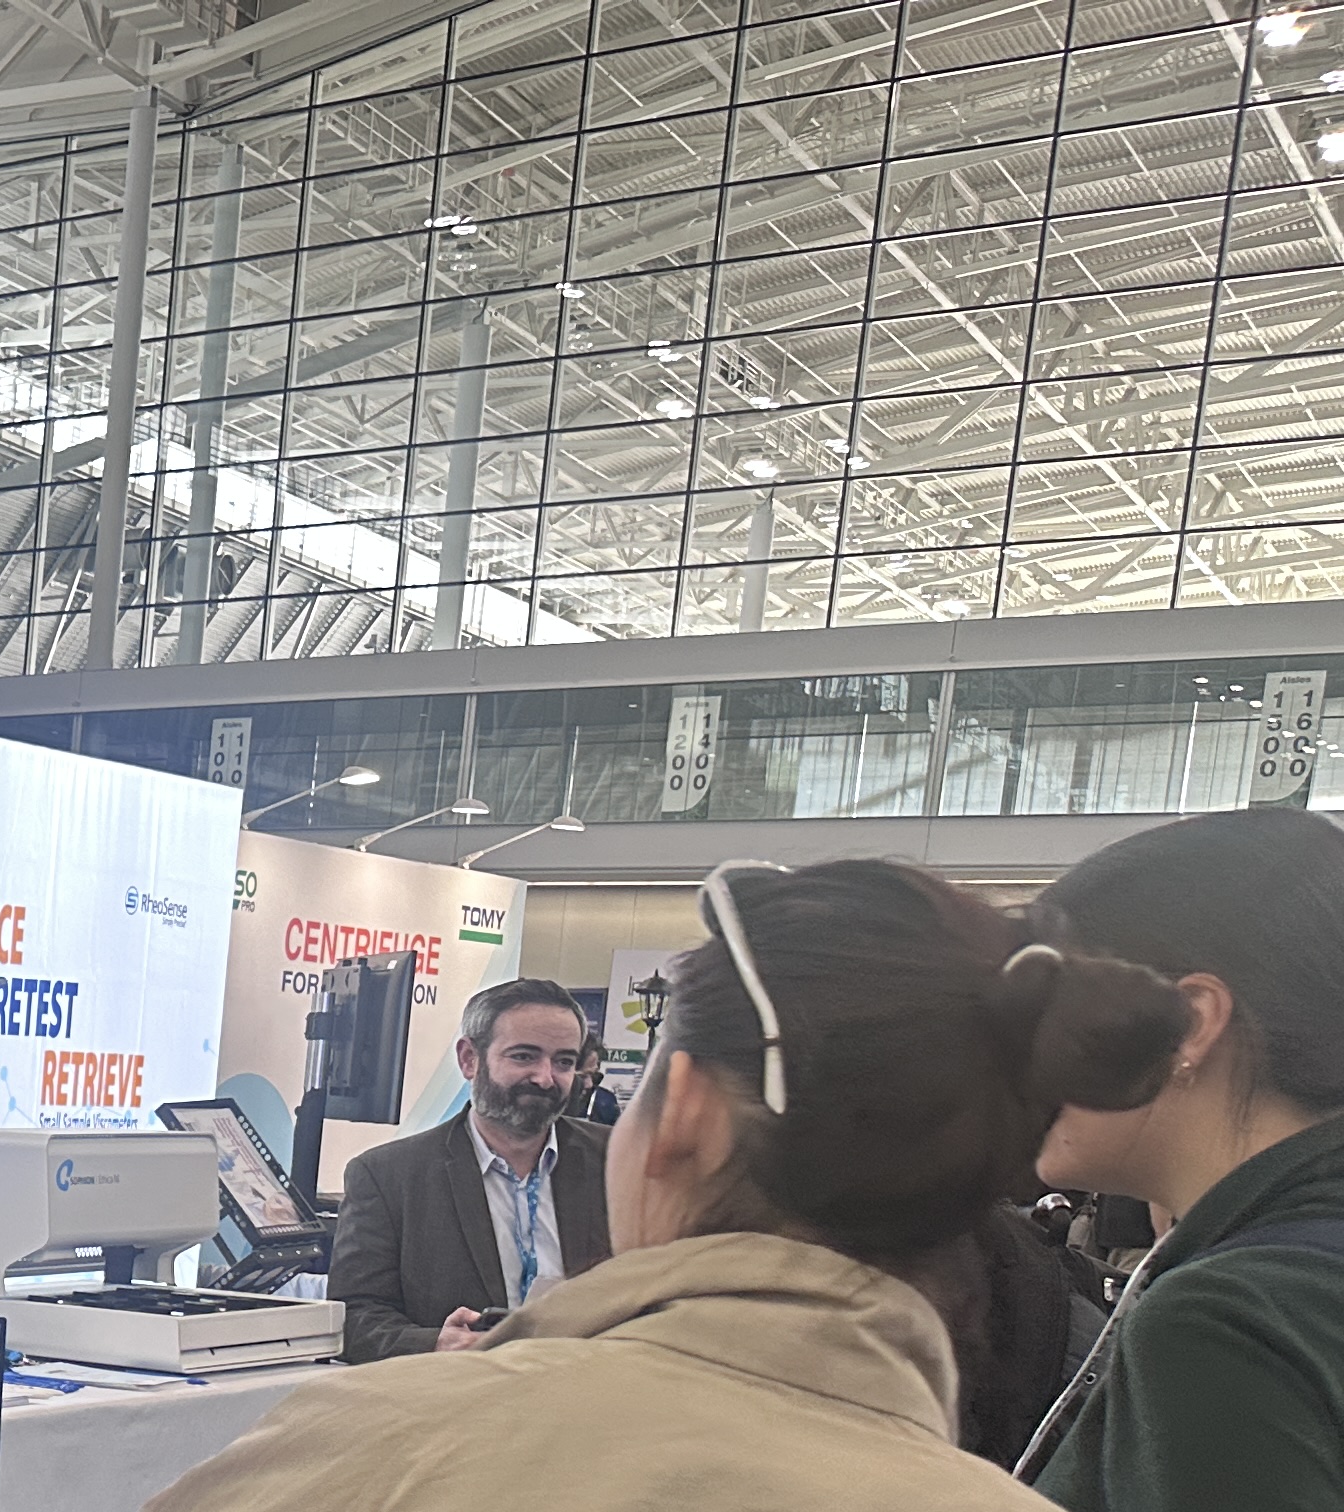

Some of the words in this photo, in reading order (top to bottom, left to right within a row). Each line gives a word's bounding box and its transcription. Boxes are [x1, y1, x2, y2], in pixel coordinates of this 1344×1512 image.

[141, 893, 188, 919] RheoSense
[461, 904, 507, 931] TOMY
[281, 969, 320, 995] FOR
[40, 1049, 145, 1108] RETRIEVE
